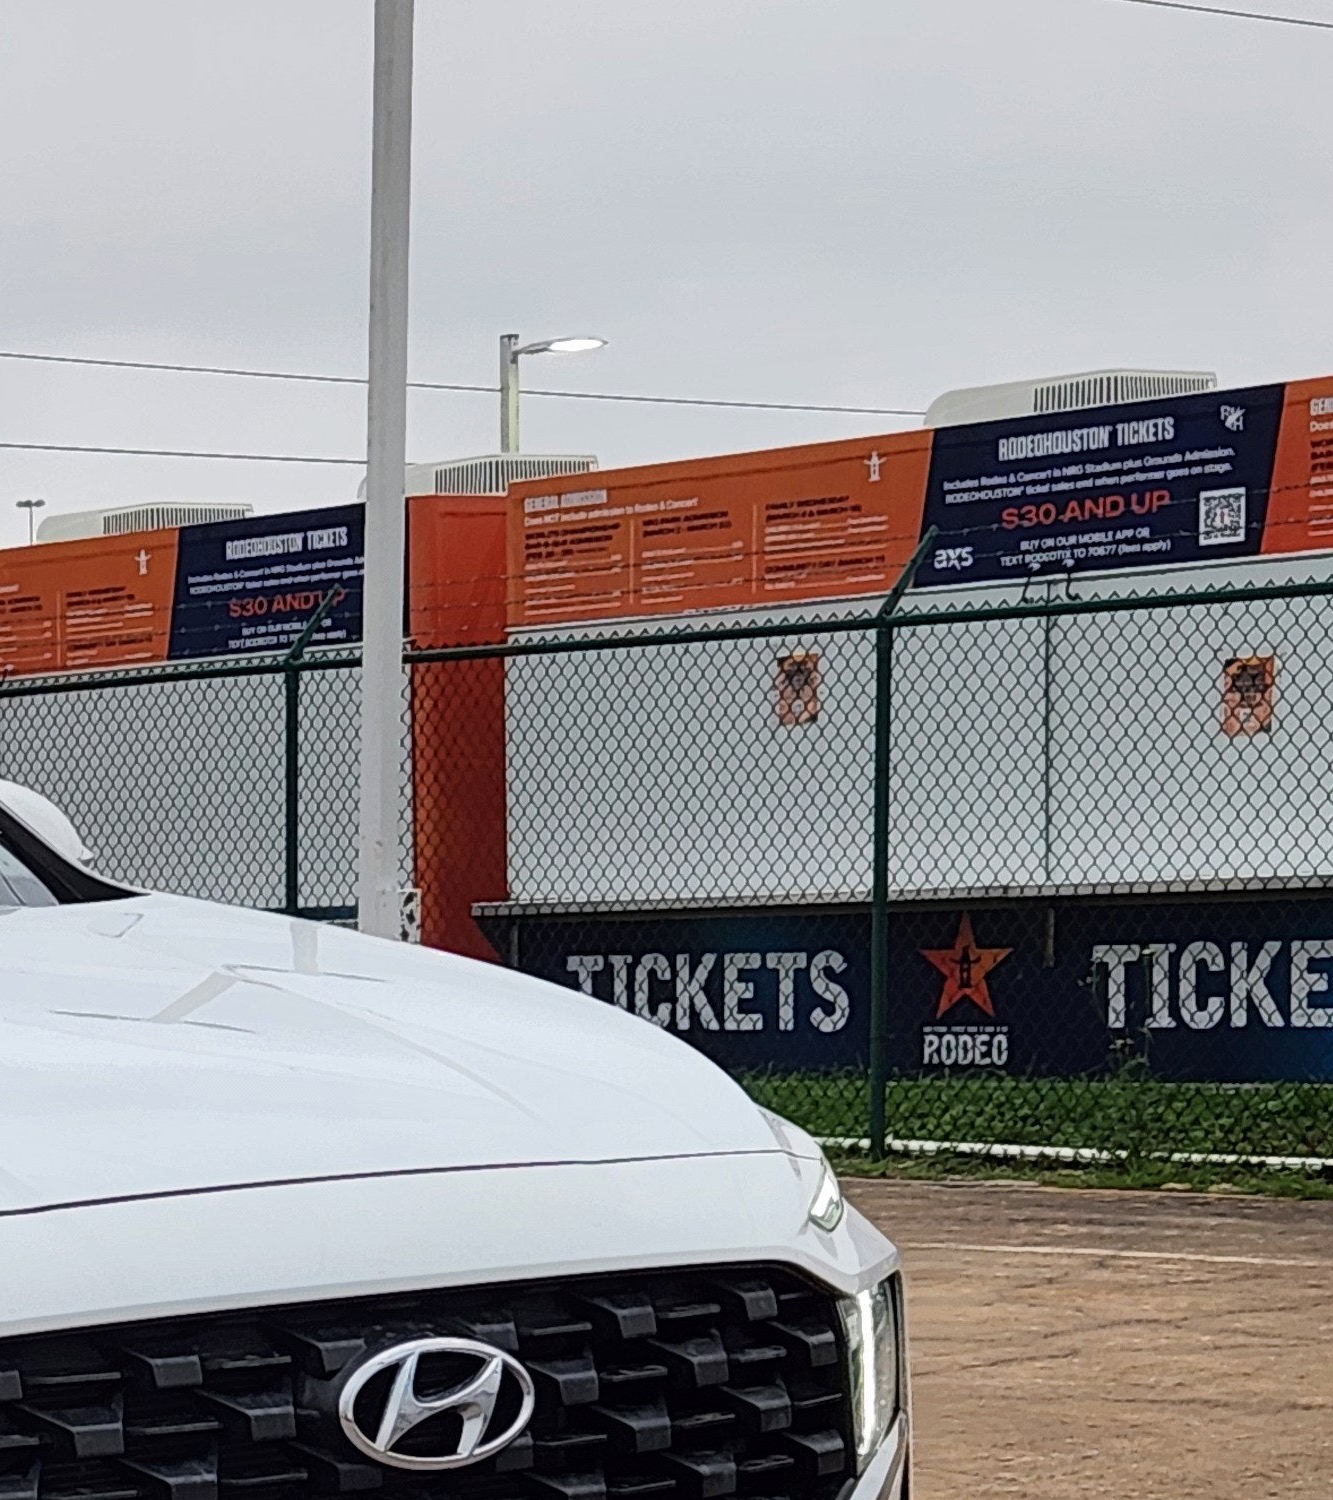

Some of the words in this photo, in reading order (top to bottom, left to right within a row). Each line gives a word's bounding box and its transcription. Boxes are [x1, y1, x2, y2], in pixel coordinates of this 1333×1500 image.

[1116, 416, 1174, 446] TICKETS
[1063, 495, 1125, 522] AND
[1131, 489, 1171, 515] UP
[271, 591, 315, 613] AND
[565, 949, 851, 1033] TICKETS
[1091, 940, 1333, 1029] TICKE
[923, 1034, 1009, 1066] RODEO
